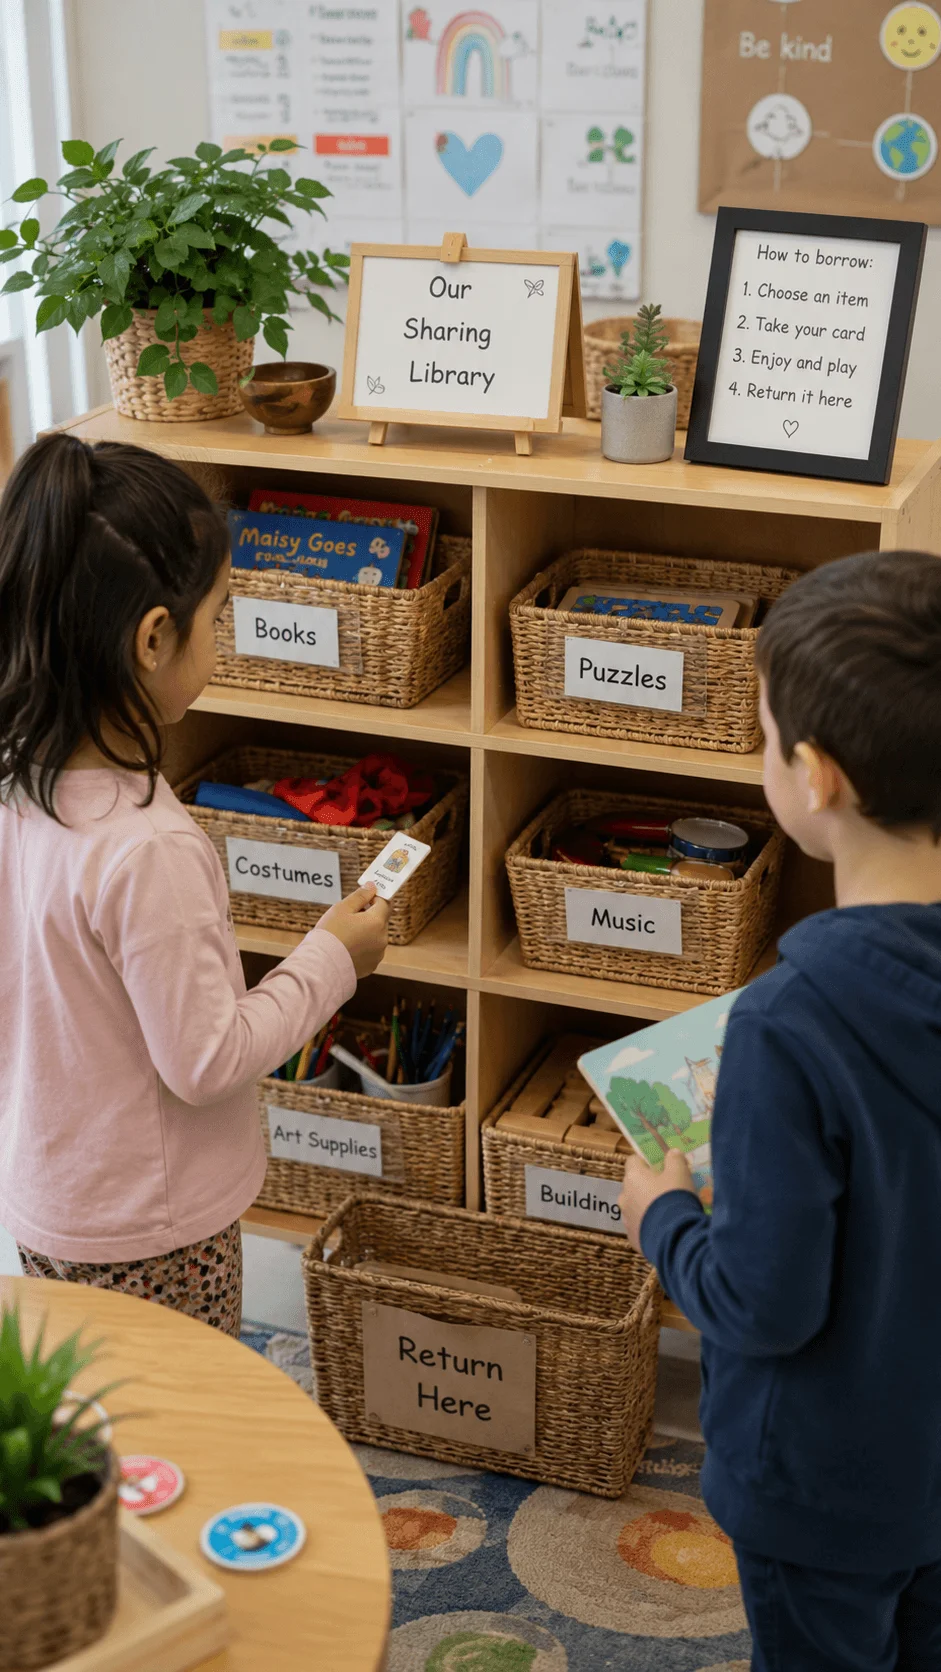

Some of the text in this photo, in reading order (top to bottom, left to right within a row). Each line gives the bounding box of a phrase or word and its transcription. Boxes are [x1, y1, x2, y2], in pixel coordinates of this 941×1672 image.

[739, 30, 833, 62] Be kind
[757, 244, 873, 269] How to borrow:
[429, 275, 472, 299] Our
[743, 281, 869, 308] 1. Choose an item
[403, 317, 491, 350] Sharing
[737, 315, 866, 342] 2. Take your card
[409, 360, 496, 394] Library
[732, 348, 857, 379] 3. Enjoy and play
[728, 381, 853, 408] 4. Return it here
[239, 527, 357, 557] Maisy Goes
[255, 617, 317, 646] Books
[579, 656, 667, 691] Puzzles
[235, 856, 334, 888] Costumes
[591, 907, 656, 934] Music
[273, 1124, 378, 1159] Art Supplies
[540, 1184, 622, 1221] Building
[398, 1335, 503, 1382] Return
[417, 1381, 492, 1422] Here
